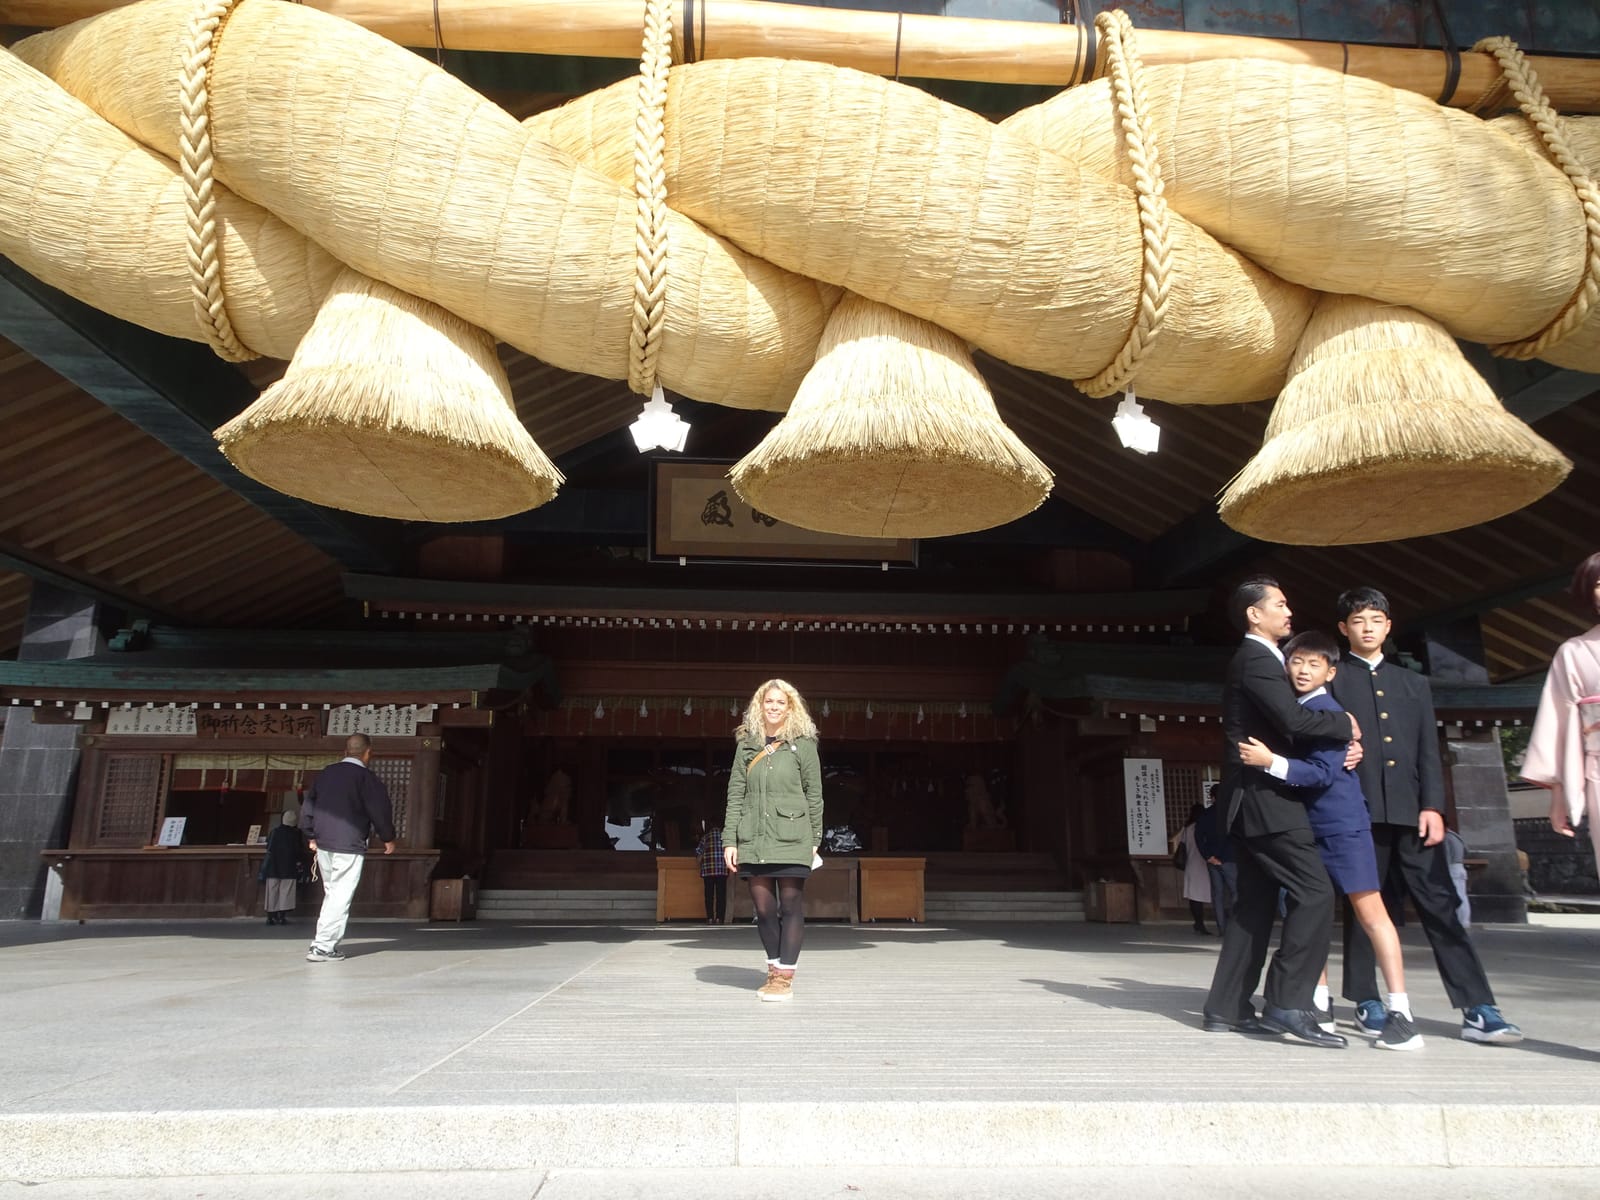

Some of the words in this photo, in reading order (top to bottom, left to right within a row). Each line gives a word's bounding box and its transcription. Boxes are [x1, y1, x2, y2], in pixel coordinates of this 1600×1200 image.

[201, 713, 315, 735] 御祈念受付所
